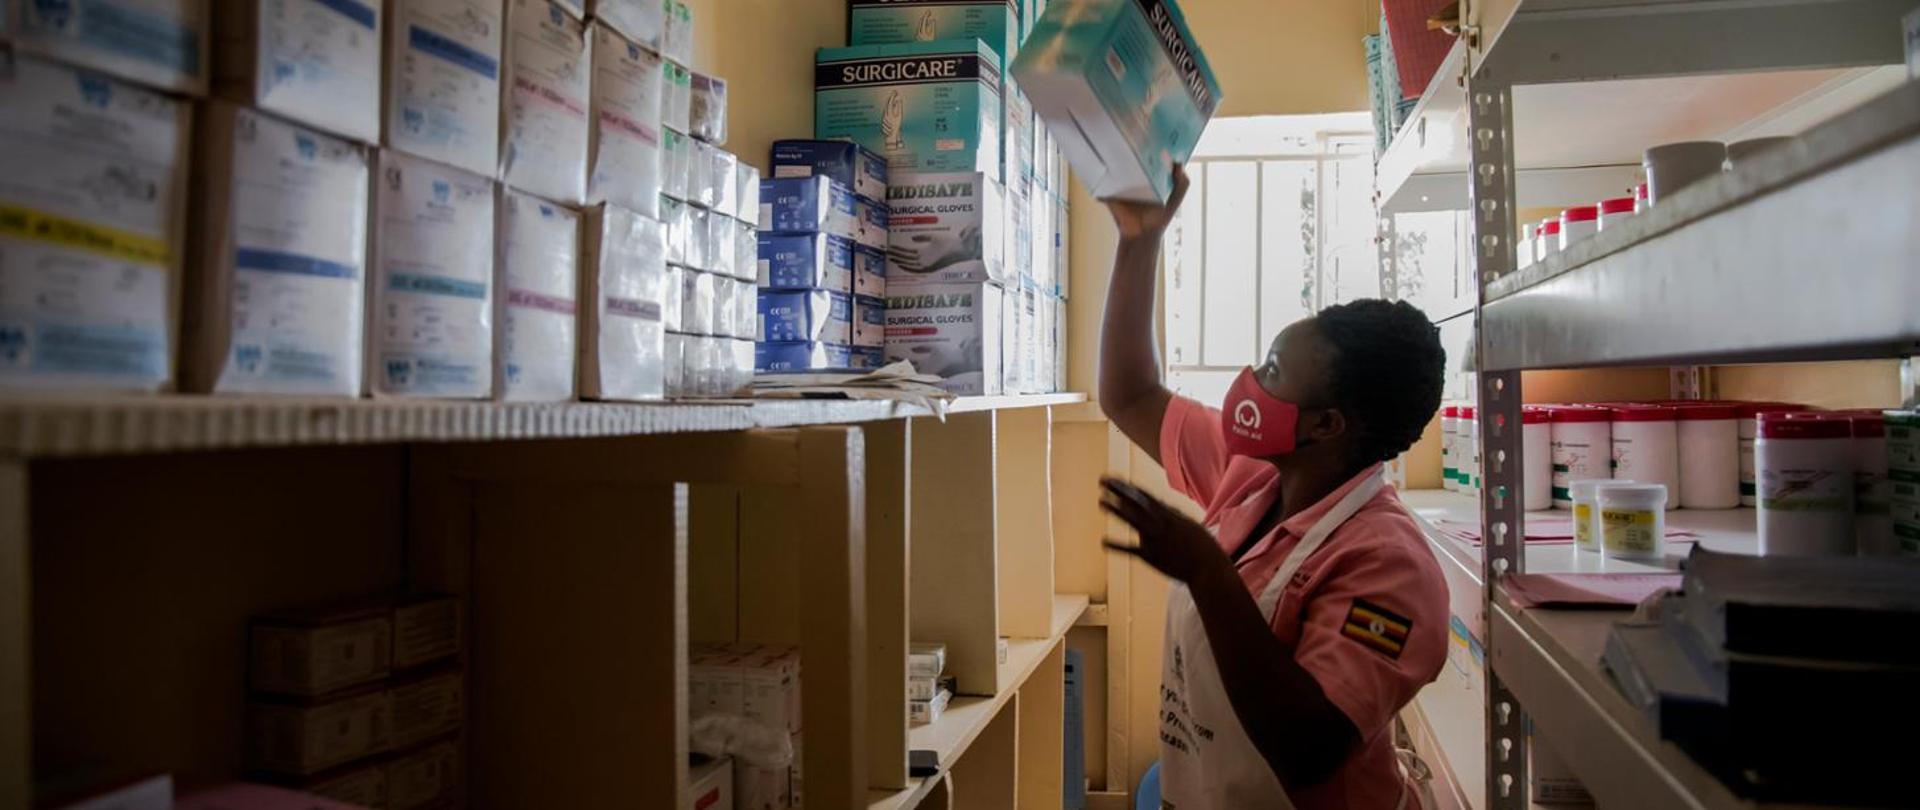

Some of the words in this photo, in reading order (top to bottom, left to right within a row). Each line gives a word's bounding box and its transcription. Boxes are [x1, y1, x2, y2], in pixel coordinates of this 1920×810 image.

[938, 203, 974, 213] GLOVES
[887, 315, 934, 325] SURGICAL
[936, 314, 973, 323] GLOVES
